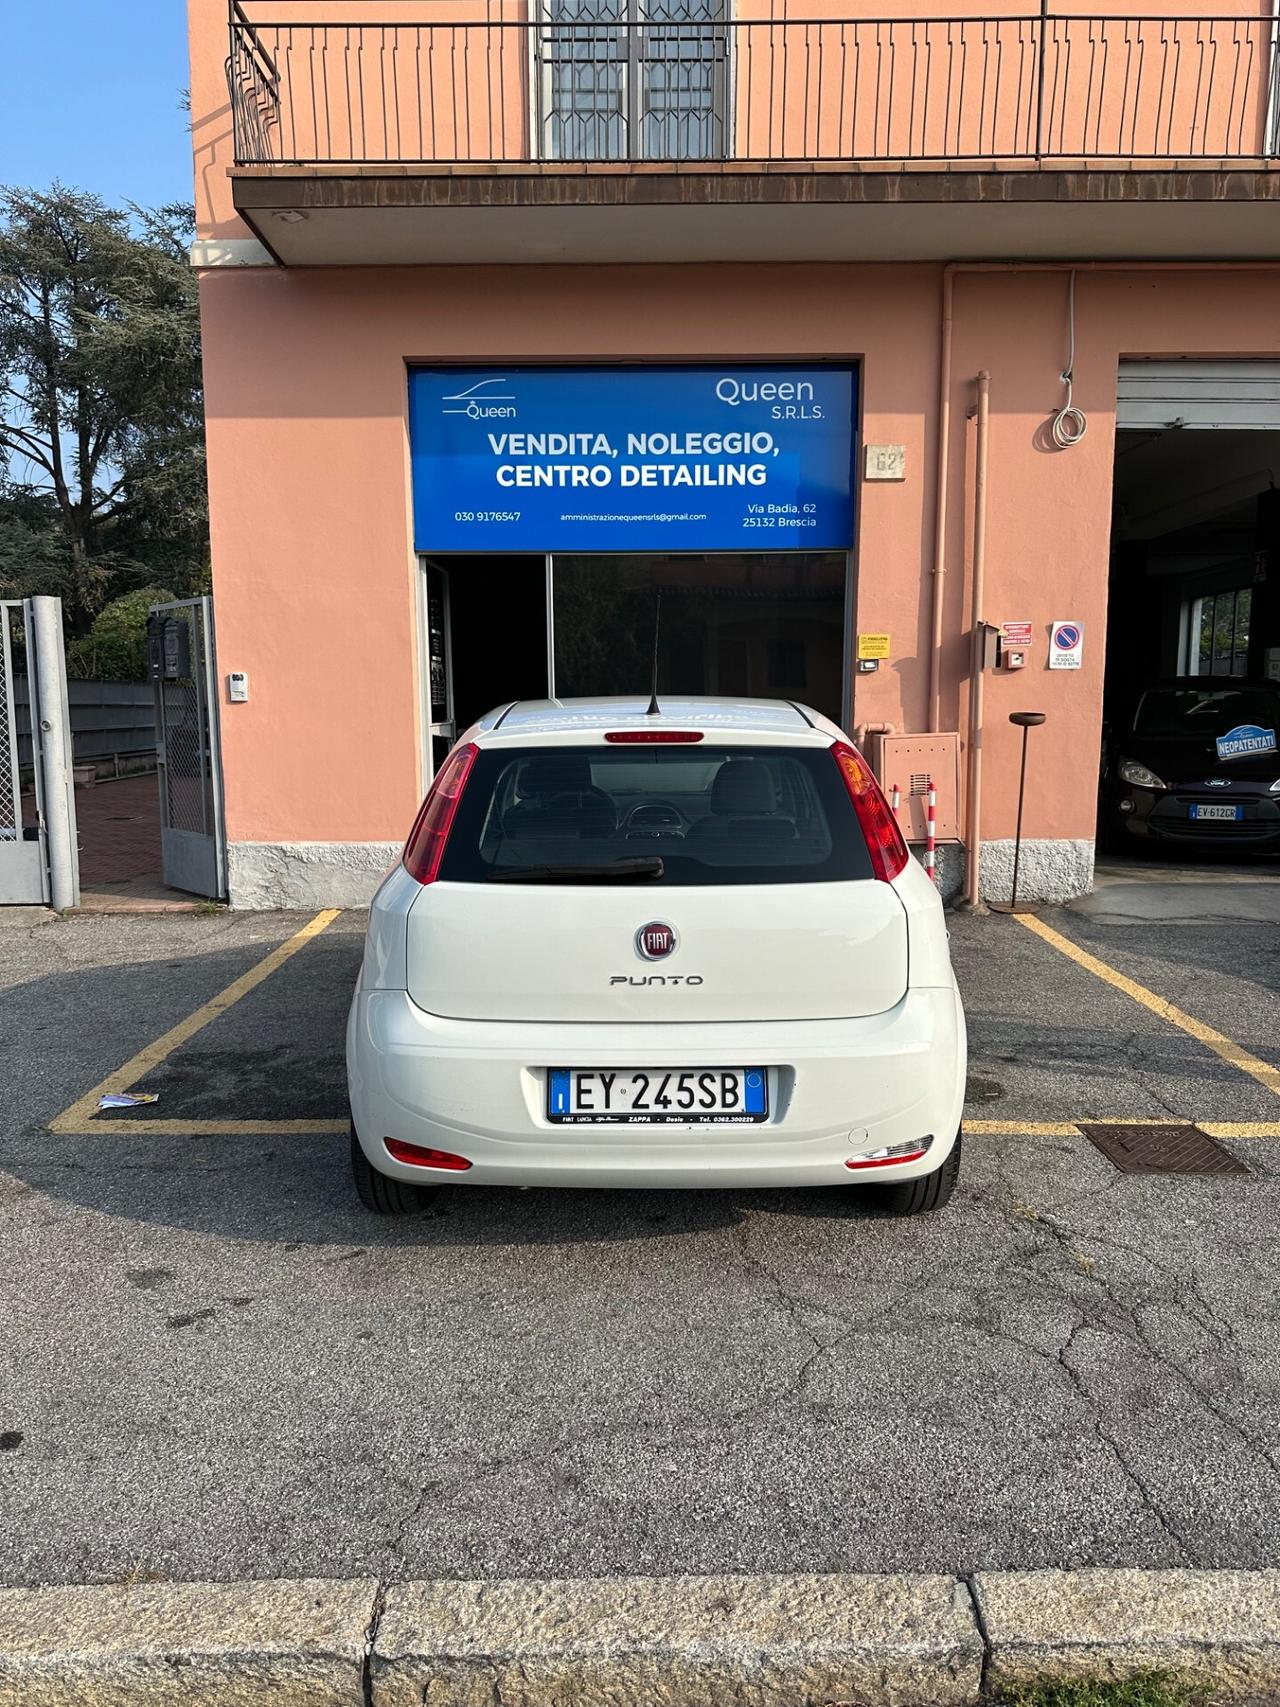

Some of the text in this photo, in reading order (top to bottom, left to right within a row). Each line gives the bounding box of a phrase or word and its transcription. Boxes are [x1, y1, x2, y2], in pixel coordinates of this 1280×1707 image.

[716, 378, 814, 405] Queen
[466, 404, 516, 420] Queen
[771, 405, 825, 419] S.R.L.S.
[487, 432, 779, 458] VENDITA, NOLEGGIO,
[496, 464, 767, 487] CENTRO DETAILING
[454, 511, 521, 522] 030 9176547
[747, 503, 817, 514] Via Badia, 62
[560, 513, 707, 523] amministrazionequeensrls@gmail.com
[742, 516, 817, 528] 25132 Brescia
[1219, 735, 1274, 754] NEOPATENTATI
[647, 932, 669, 950] FIAT
[609, 976, 704, 986] PUNTO
[576, 1073, 616, 1109] EY
[631, 1073, 739, 1110] 245SB
